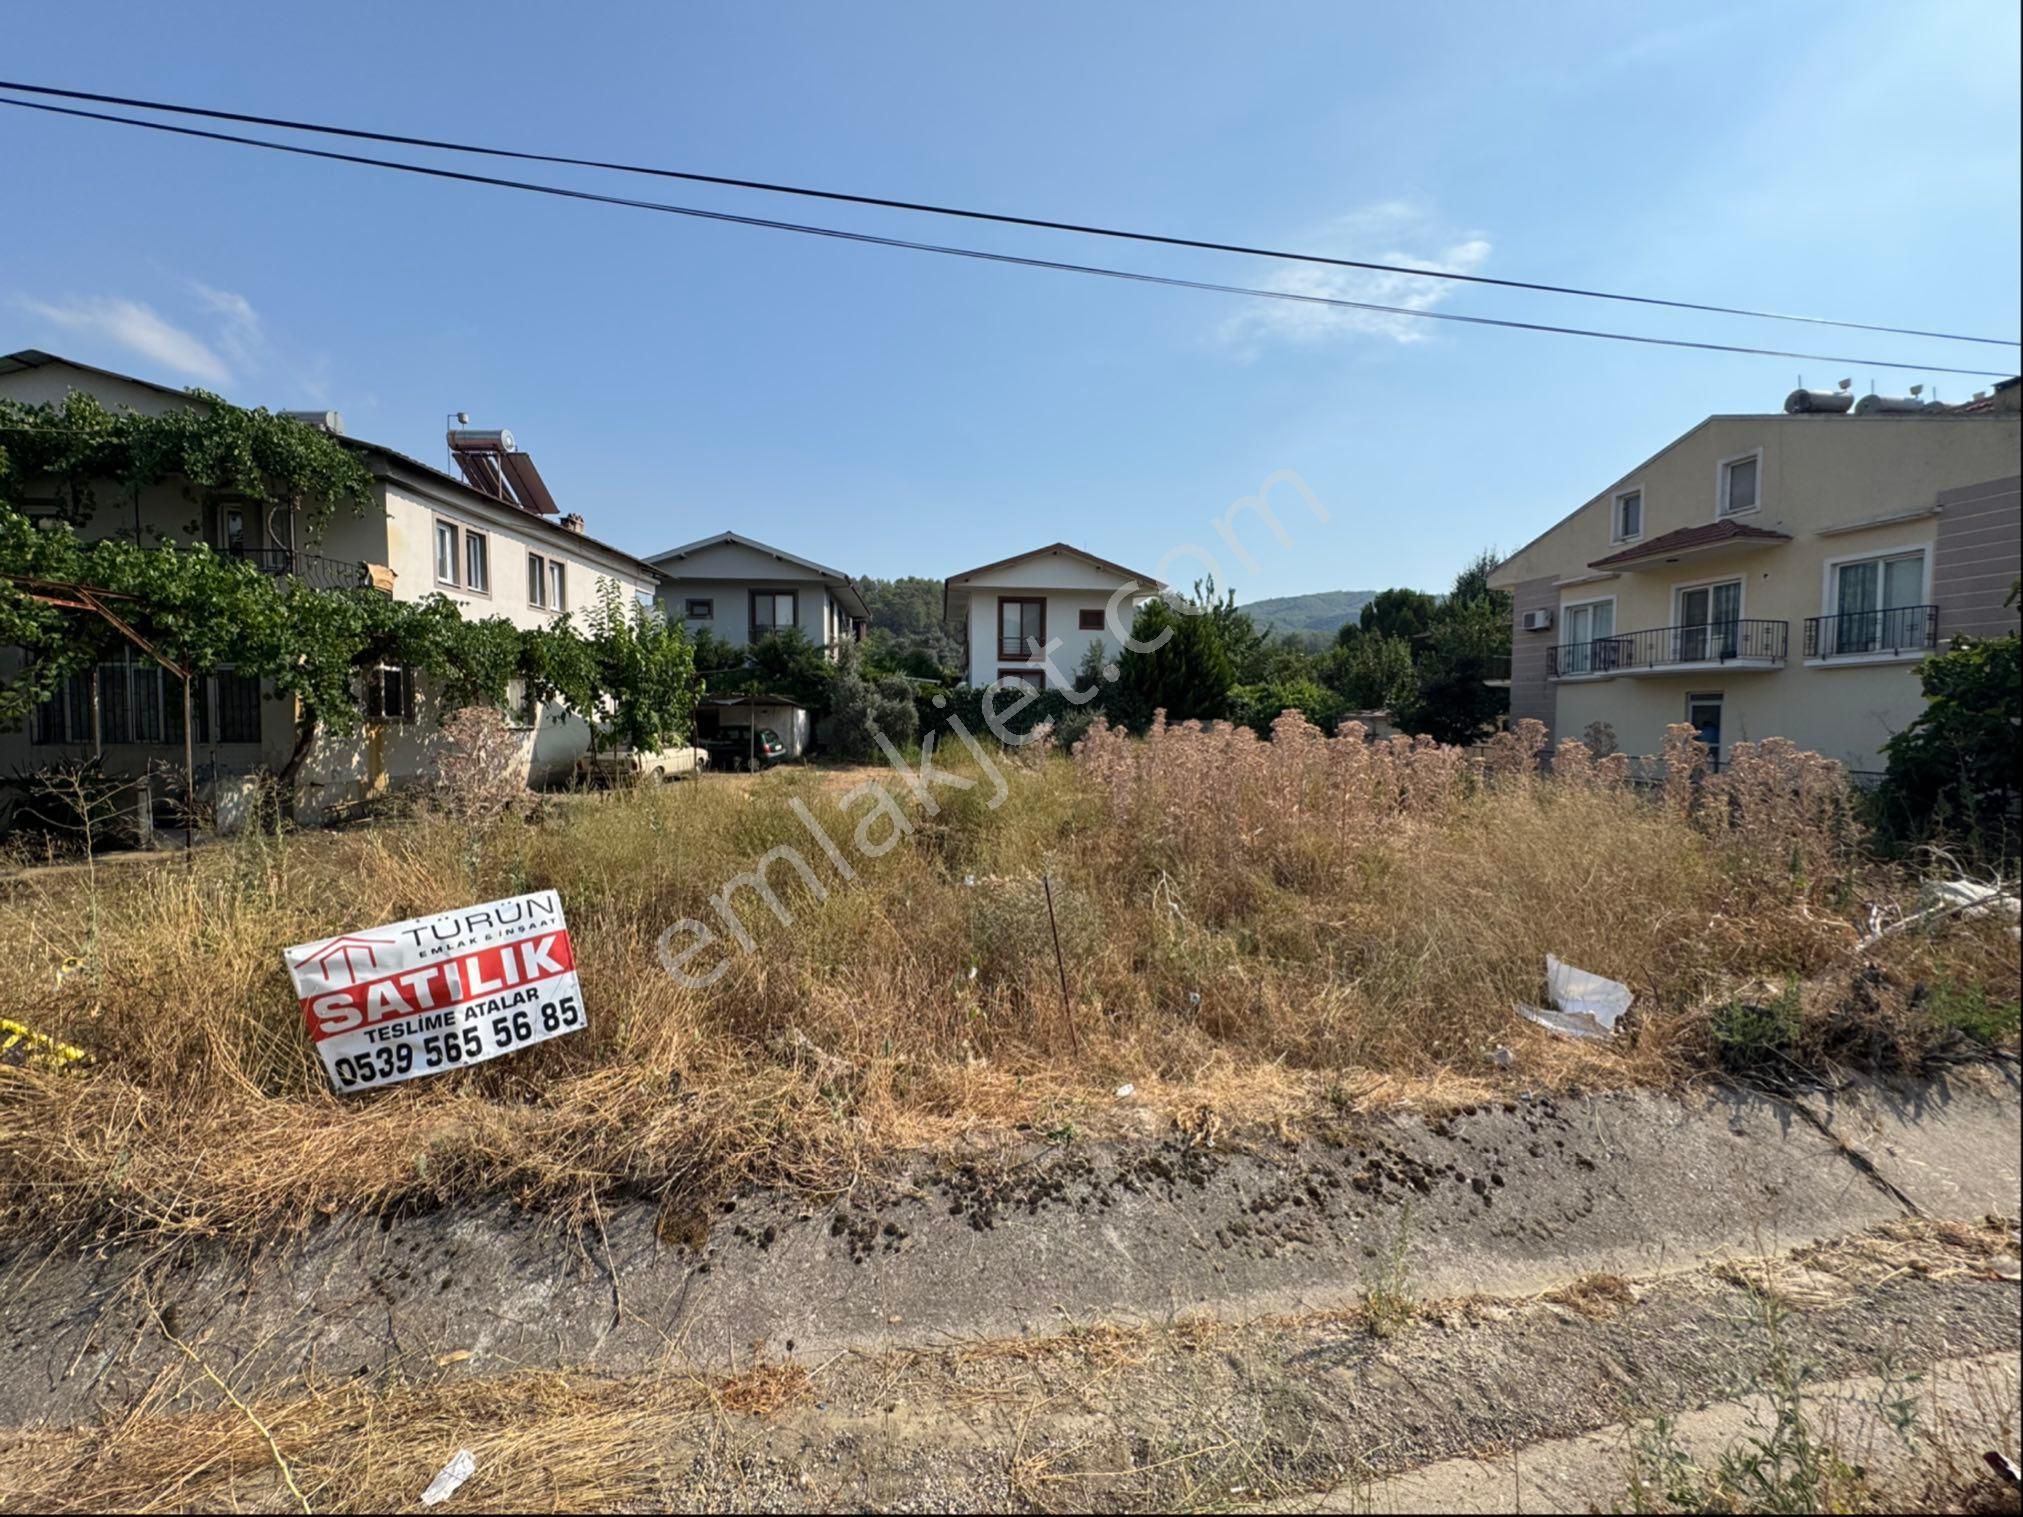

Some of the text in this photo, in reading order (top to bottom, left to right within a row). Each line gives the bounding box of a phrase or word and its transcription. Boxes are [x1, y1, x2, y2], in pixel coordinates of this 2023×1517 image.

[402, 895, 554, 947] TÜRÜN
[420, 937, 477, 958] EMLAK
[312, 934, 564, 1034] SATILIK
[334, 996, 578, 1087] 0539 565 56 85
[364, 987, 539, 1043] TESLİME ATALAR
